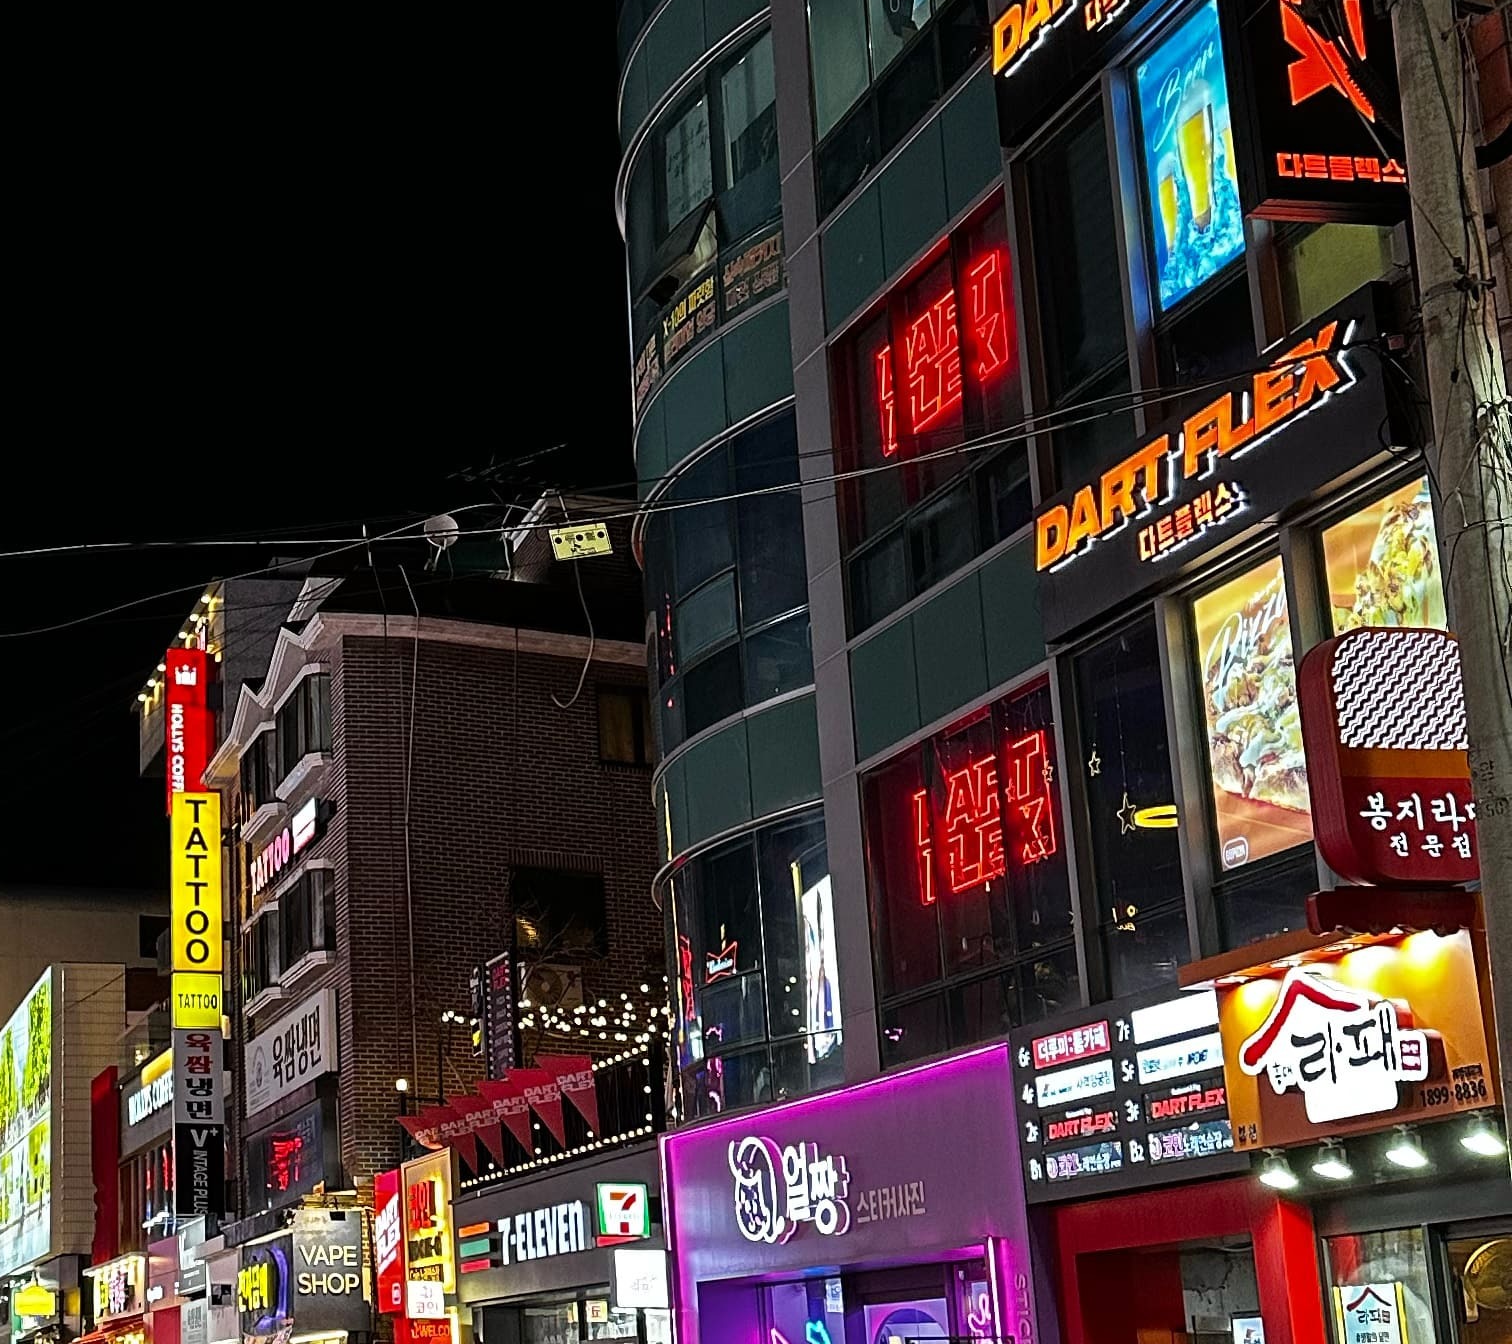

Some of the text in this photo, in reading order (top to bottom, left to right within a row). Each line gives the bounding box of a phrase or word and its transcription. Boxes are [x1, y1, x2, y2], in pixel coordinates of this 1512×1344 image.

[1277, 152, 1407, 183] 다트플렉스
[1036, 320, 1340, 572] DART FLEX
[1139, 482, 1236, 561] 다트플렉스
[1390, 831, 1472, 858] 전문점
[250, 827, 290, 896] TATTOO
[185, 799, 209, 965] TATTOO
[178, 993, 218, 1010] TATTOO
[271, 1005, 323, 1089] 육쌈냉면
[184, 1033, 214, 1121] 육쌈냉면
[556, 1070, 593, 1086] DART
[561, 1077, 596, 1092] FLEX
[1152, 1096, 1188, 1119] DART
[1188, 1087, 1226, 1112] FLEX
[1048, 1118, 1080, 1140] DART
[1080, 1111, 1114, 1134] FLEX
[856, 1180, 926, 1224] 스티커사진
[497, 1200, 586, 1266] 7-ELEVEN
[299, 1244, 358, 1268] VAPE
[298, 1272, 360, 1296] SHOP
